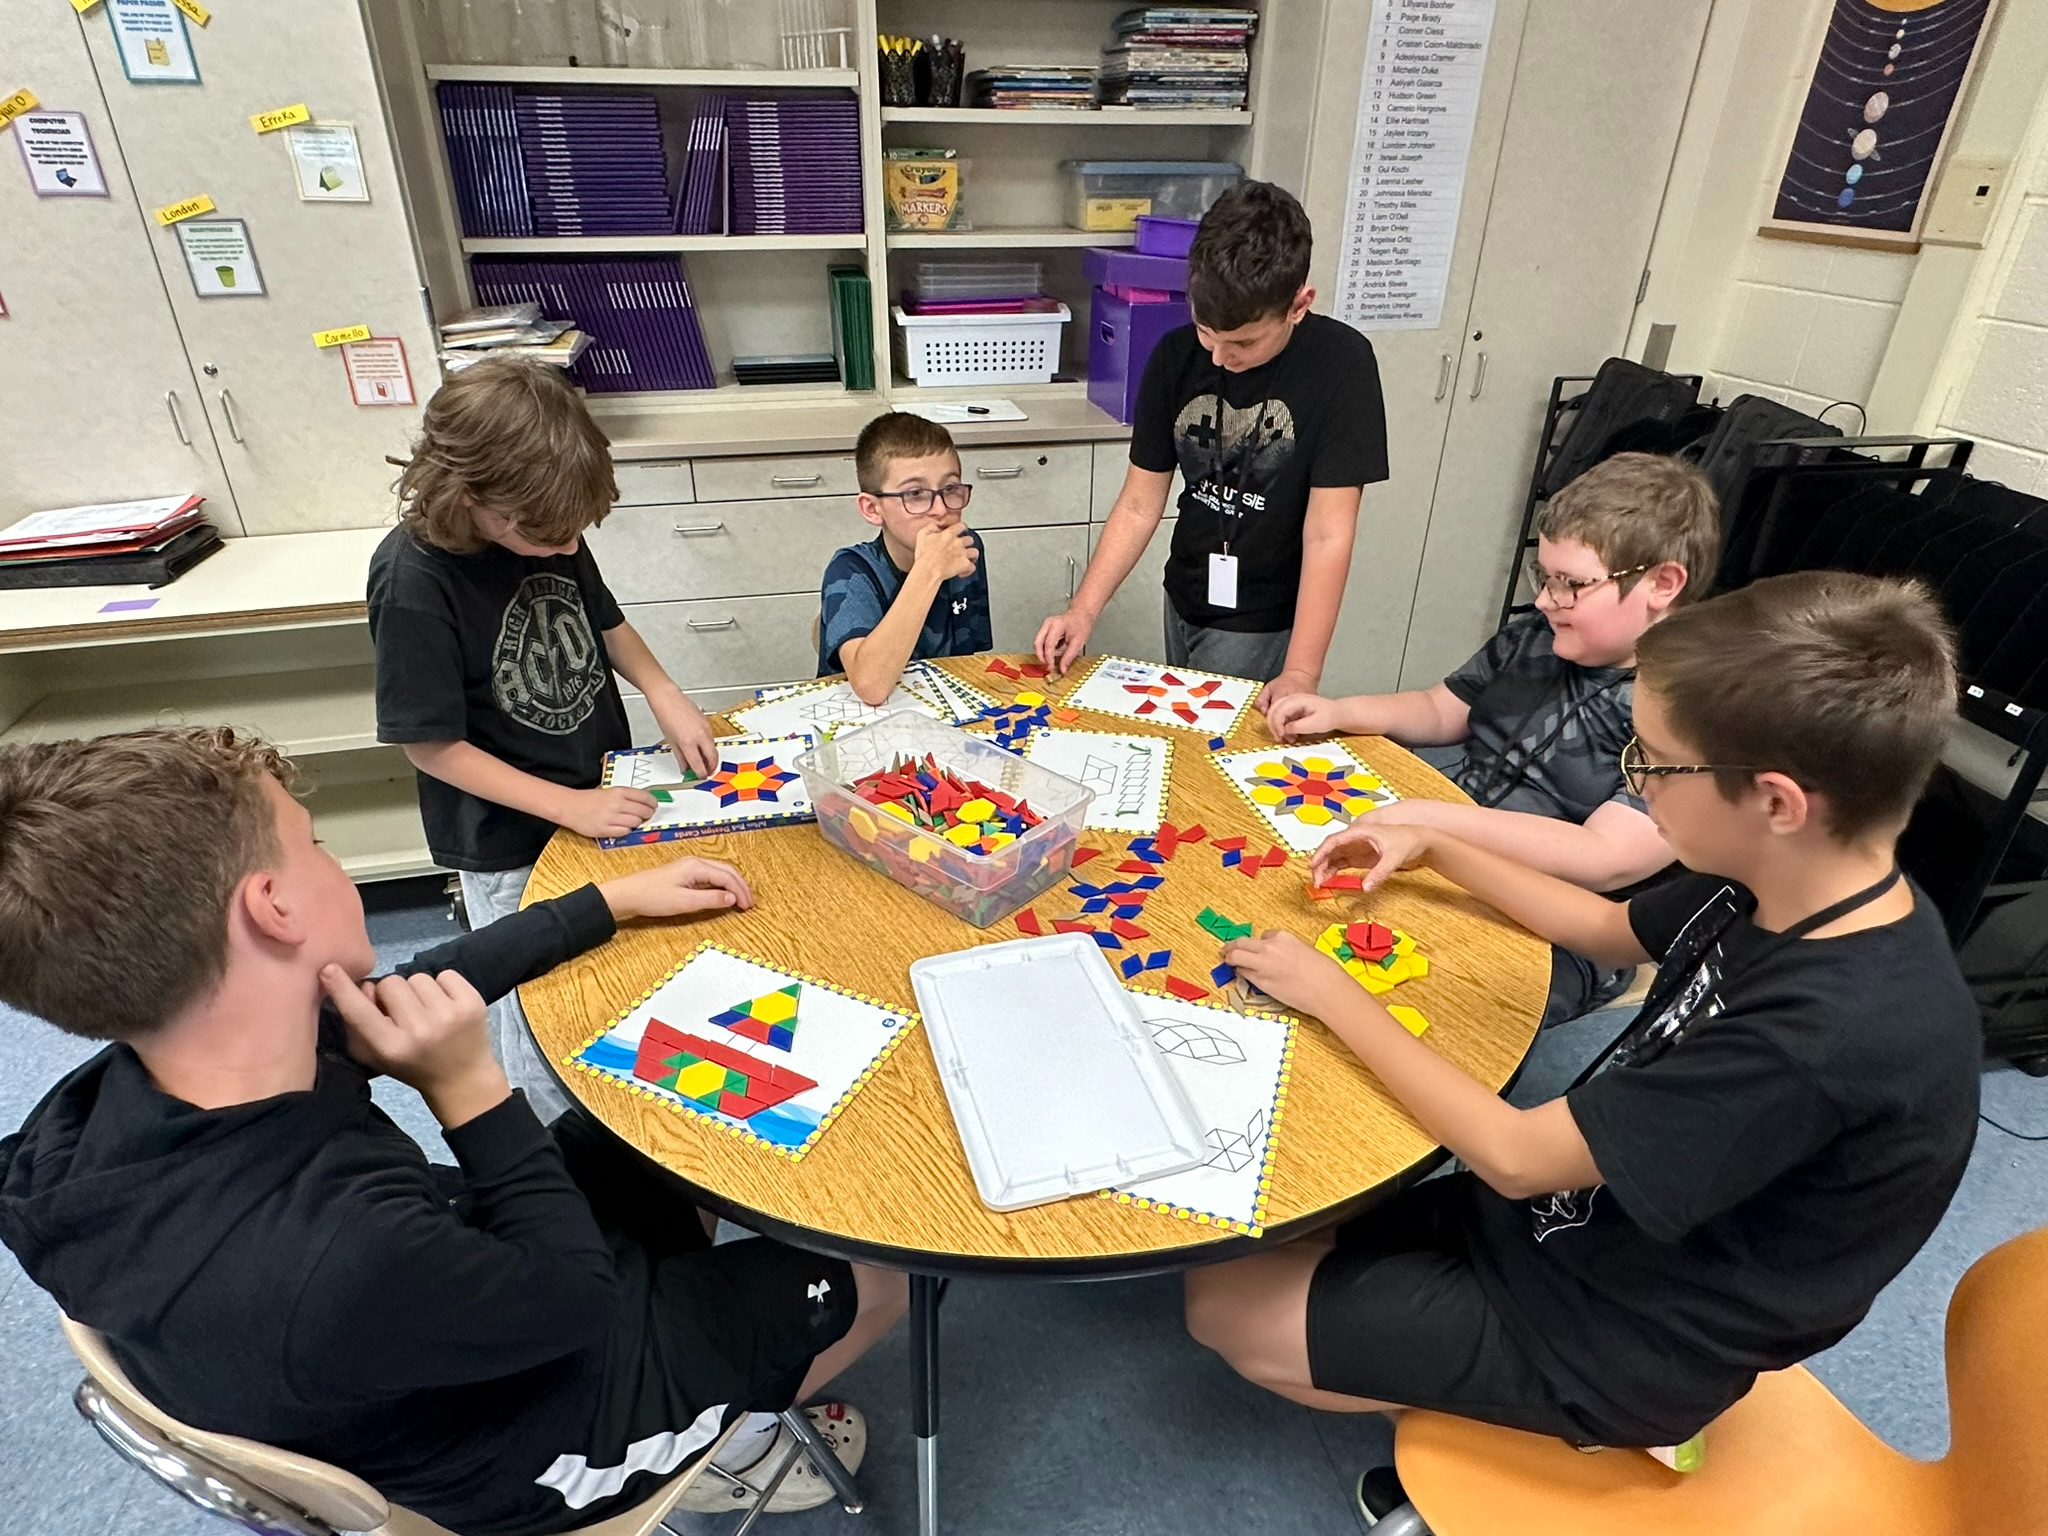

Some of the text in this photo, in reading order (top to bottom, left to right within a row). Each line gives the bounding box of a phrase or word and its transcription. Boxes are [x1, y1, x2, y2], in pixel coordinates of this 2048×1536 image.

[1377, 65, 1385, 73] 10
[1373, 91, 1382, 99] 12
[0, 103, 17, 120] yan
[1372, 104, 1380, 112] 13
[1369, 129, 1377, 137] 15
[1365, 153, 1373, 161] 17
[904, 165, 941, 174] Crayola
[162, 202, 200, 221] London
[901, 201, 948, 216] MARKERS
[561, 675, 584, 701] 1976
[674, 829, 700, 838] Cards
[701, 826, 731, 835] Design
